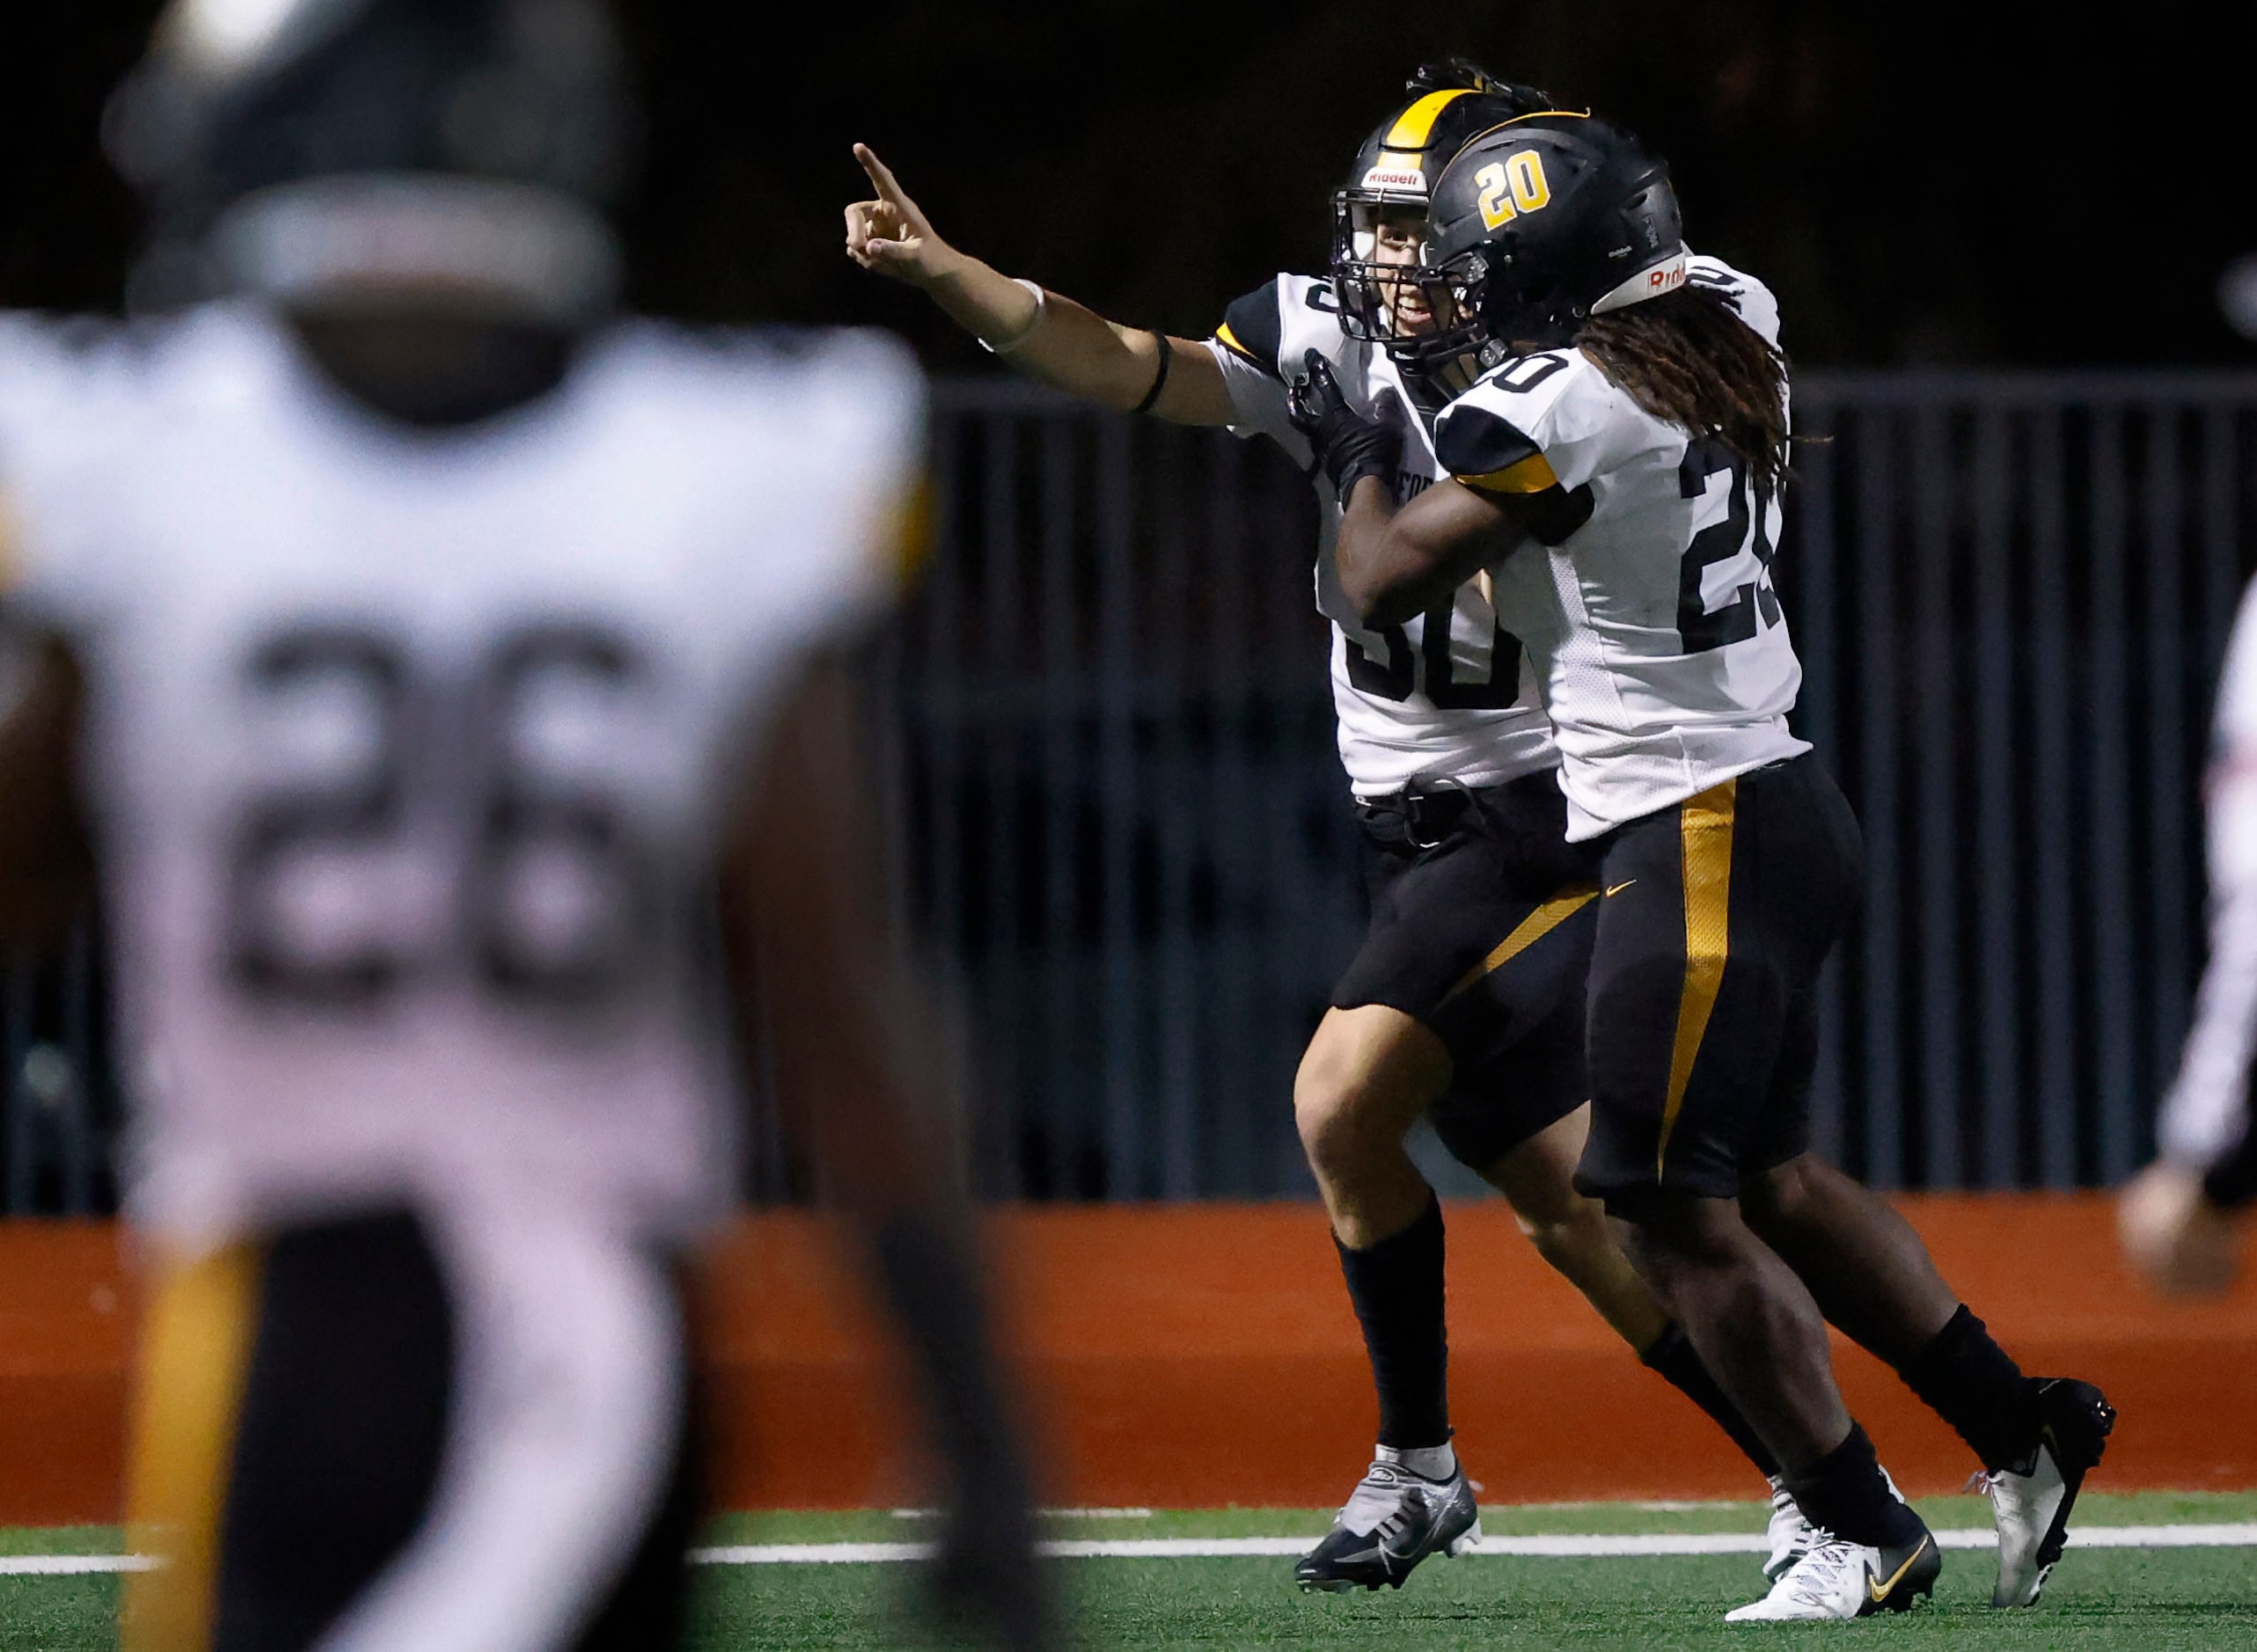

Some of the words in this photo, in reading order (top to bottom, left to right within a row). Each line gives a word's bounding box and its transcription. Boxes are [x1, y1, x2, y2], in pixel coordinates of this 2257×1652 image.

[1369, 172, 1418, 186] Riddell
[1474, 150, 1550, 232] 20
[1459, 354, 1569, 393] 0
[222, 616, 678, 1007] 26
